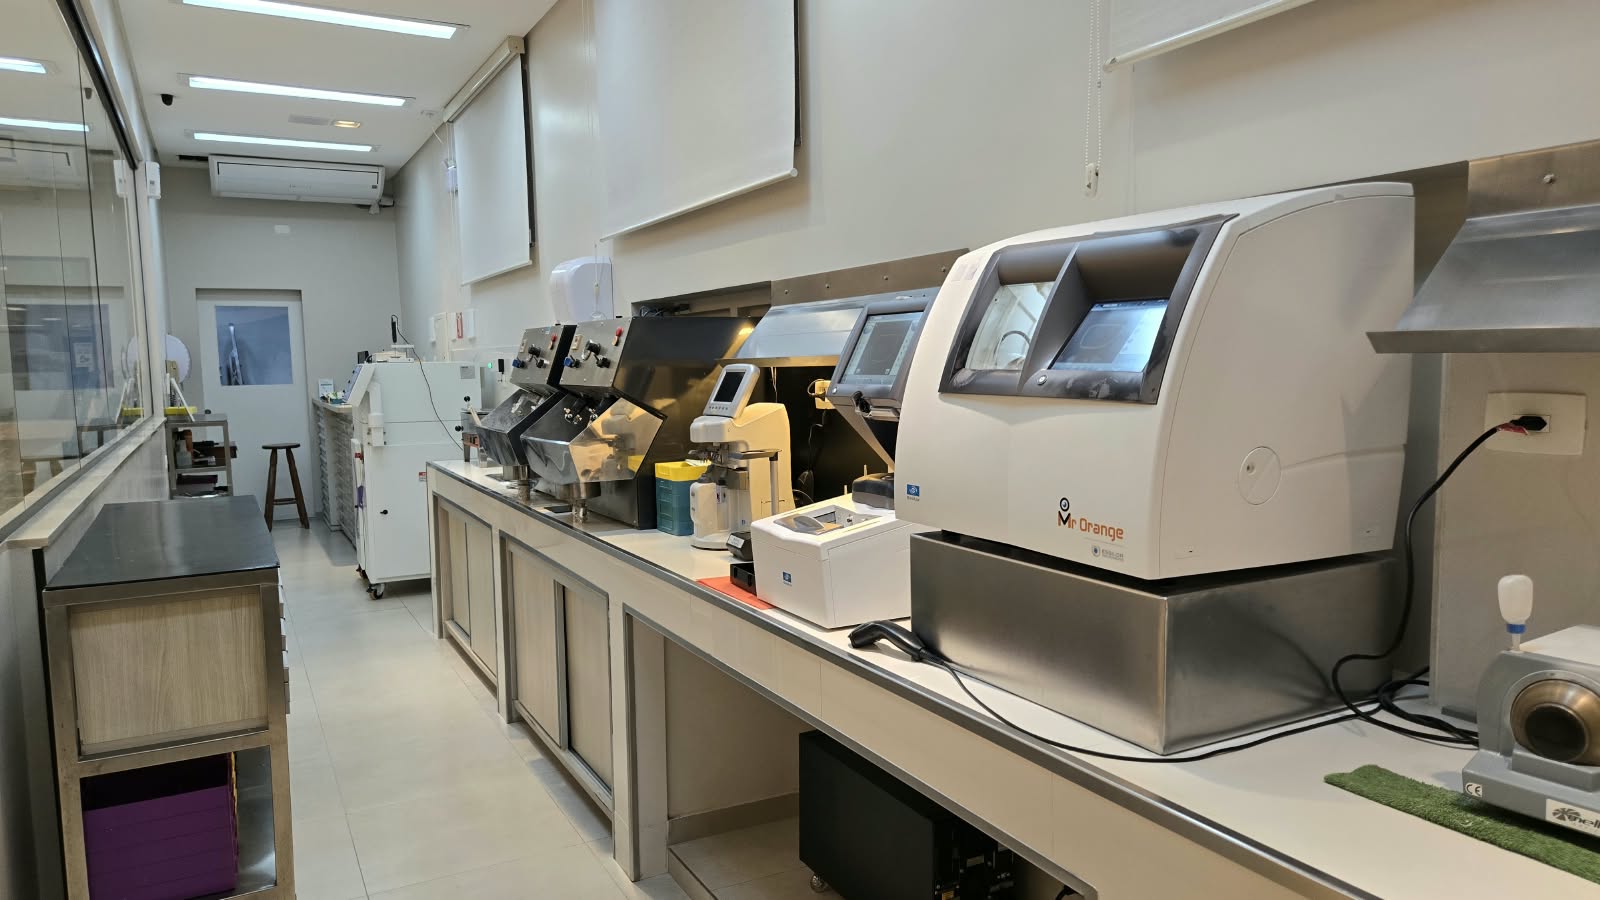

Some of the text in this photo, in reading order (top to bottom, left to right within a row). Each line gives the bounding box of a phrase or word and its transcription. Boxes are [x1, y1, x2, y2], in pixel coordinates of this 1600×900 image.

[1058, 511, 1123, 541] Mr Orange
[1467, 784, 1481, 796] CE
